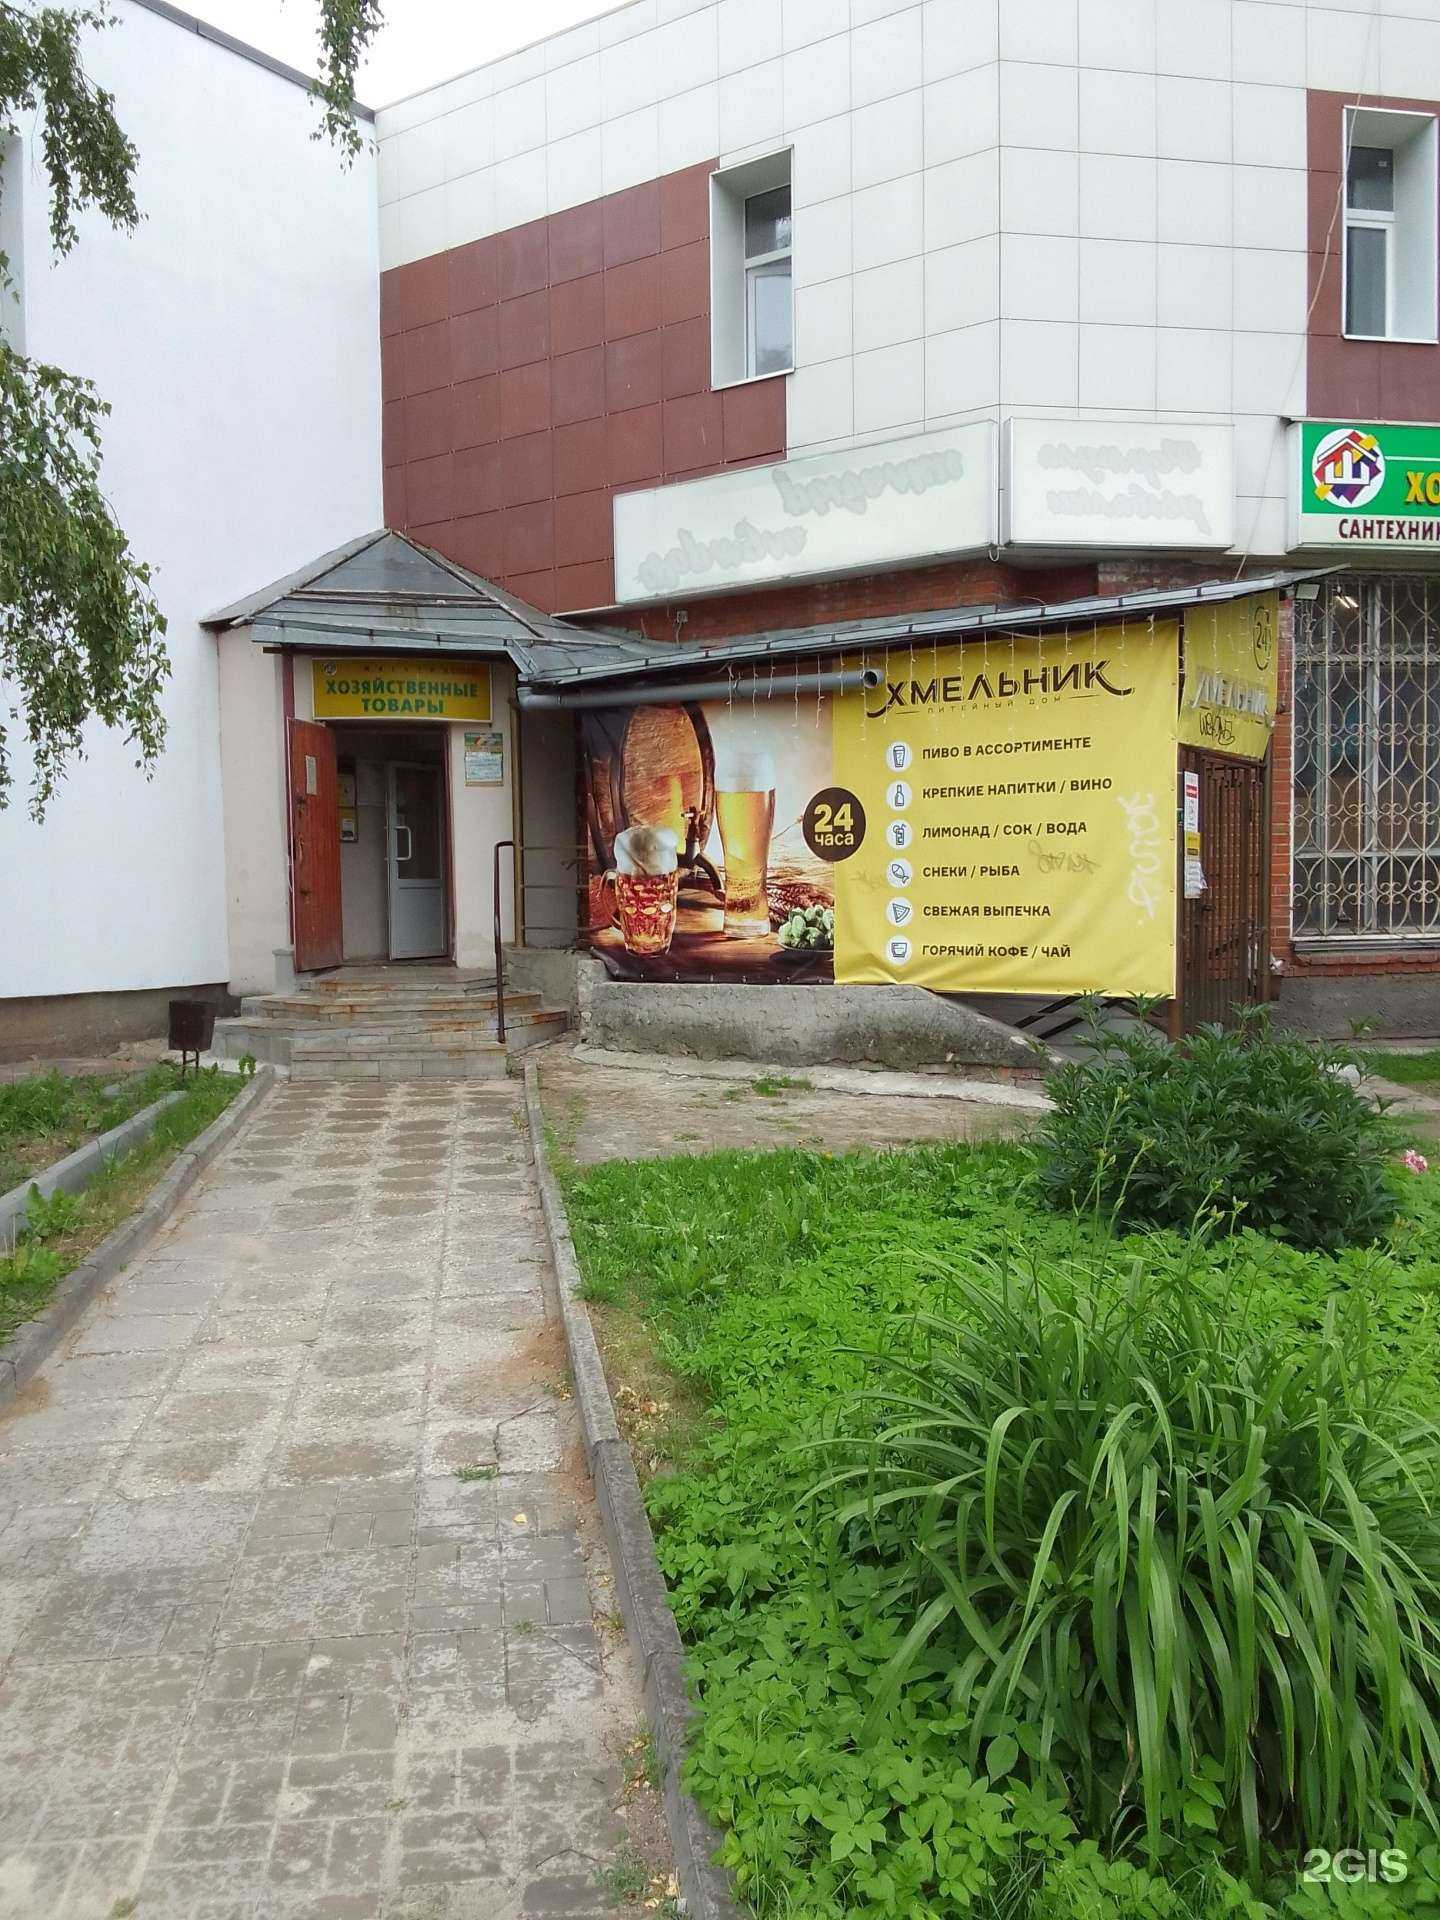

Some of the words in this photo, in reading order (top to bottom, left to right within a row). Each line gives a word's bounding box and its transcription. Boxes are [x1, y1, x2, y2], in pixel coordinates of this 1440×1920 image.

[326, 677, 479, 698] ХОЗЯЙСТВЕННЫЕ
[867, 660, 1135, 719] ХМЕЛЬНИК
[361, 698, 444, 714] ТОВАРЫ
[927, 701, 1014, 715] ПИТЕЙНЫЙ
[1029, 696, 1061, 706] ДОМ
[922, 746, 960, 760] ПИВО
[963, 745, 972, 757] В
[975, 737, 1092, 757] АССОРТИМЕНТЕ
[922, 785, 985, 800] КРЕПКИЕ
[987, 781, 1056, 797] НАПИТКИ
[1070, 778, 1113, 792] ВИНО
[813, 803, 854, 832] 24
[814, 831, 855, 847] часа
[922, 826, 990, 839] ЛИМОНАД
[1003, 823, 1033, 836] СОК
[1046, 821, 1087, 836] ВОДА
[922, 866, 968, 878] СНЕКИ
[980, 865, 1020, 877] РЫБА
[922, 905, 980, 917] СВЕЖАЯ
[983, 905, 1051, 918] ВЫПЕЧКА
[922, 944, 984, 957] ГОРЯЧИЙ
[988, 945, 1029, 958] КОФЕ
[1041, 944, 1071, 958] ЧАЙ
